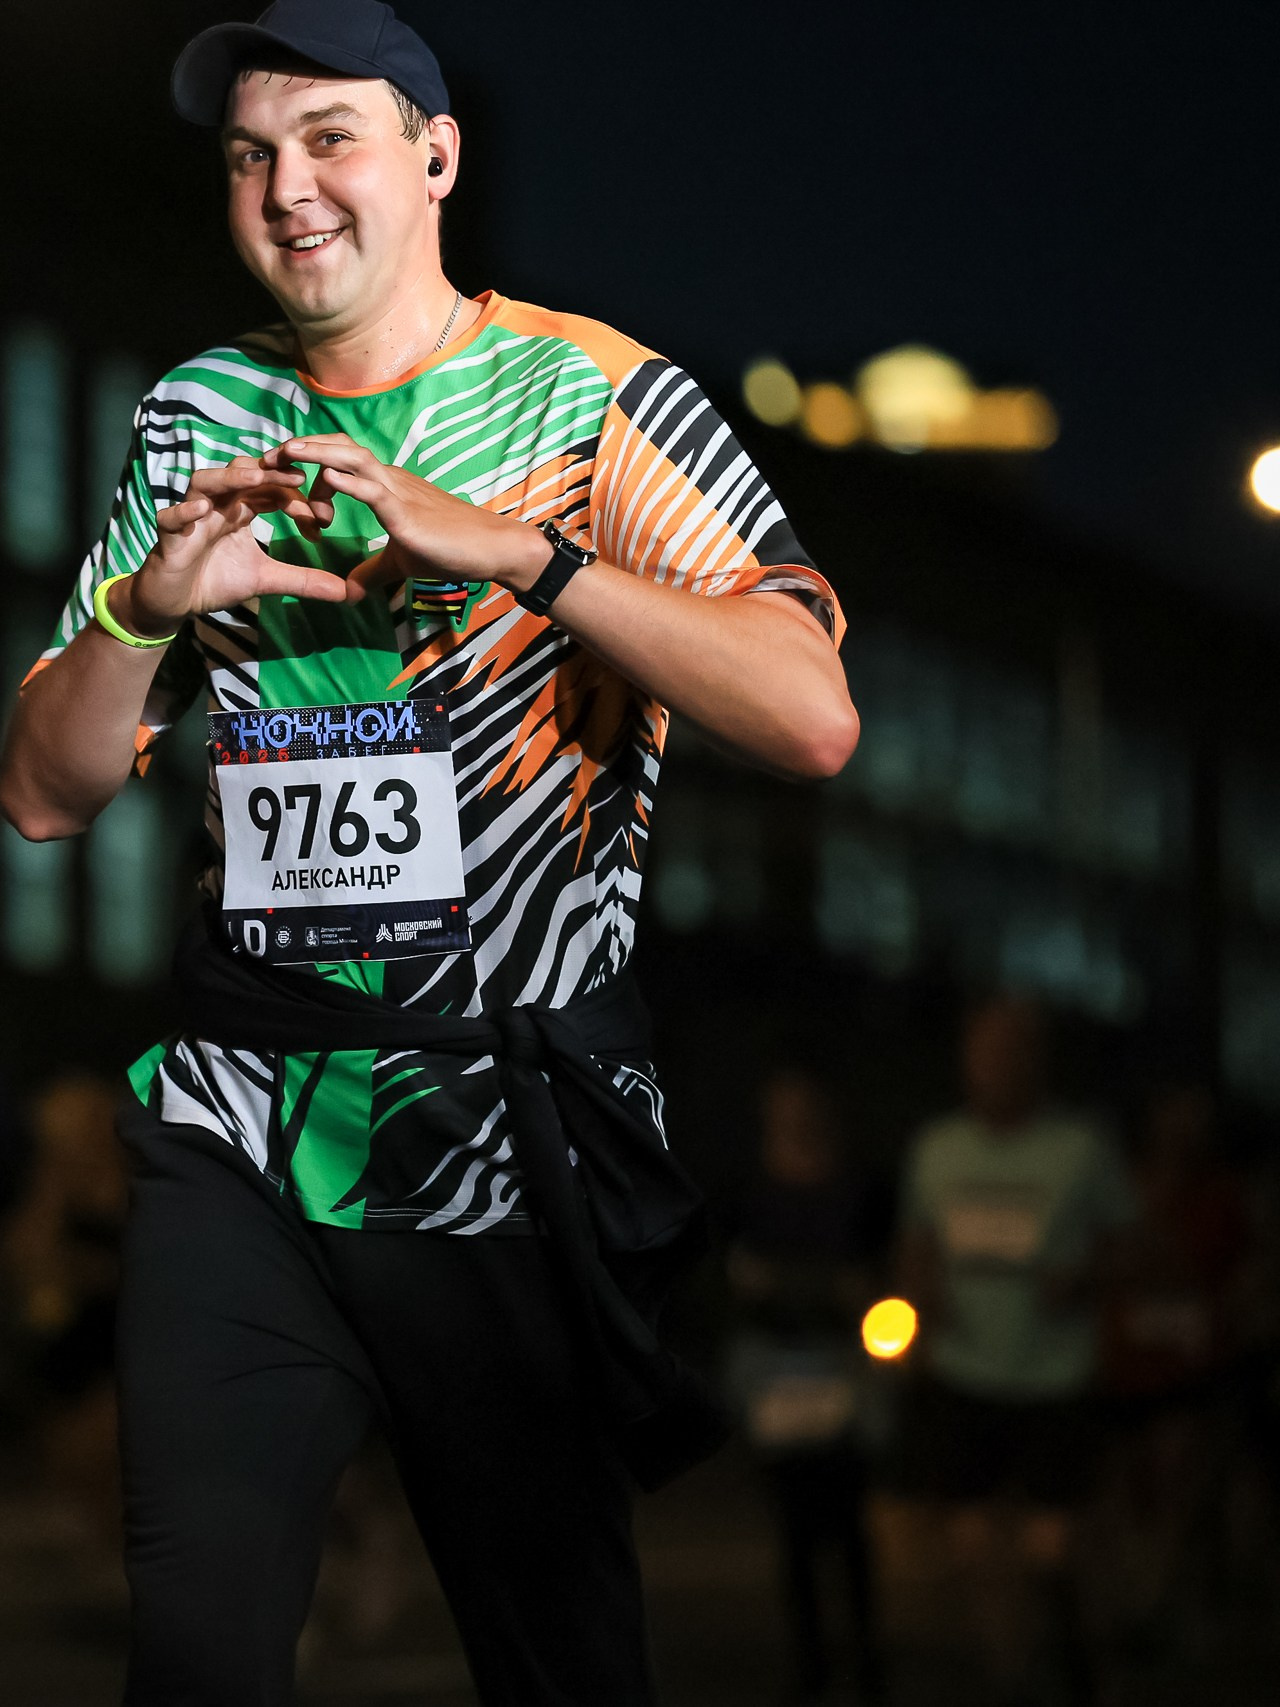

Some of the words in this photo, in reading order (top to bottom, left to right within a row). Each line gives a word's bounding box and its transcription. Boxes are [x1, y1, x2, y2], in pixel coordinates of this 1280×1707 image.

[231, 700, 421, 750] НОЧНОЙ
[221, 748, 289, 766] 2026
[316, 744, 388, 760] ЗАБЕГ
[247, 778, 422, 862] 9763
[271, 864, 401, 891] АЛЕКСАНДР
[394, 917, 443, 932] МОСКОВСКИЙ
[395, 930, 418, 942] СПОРТ
